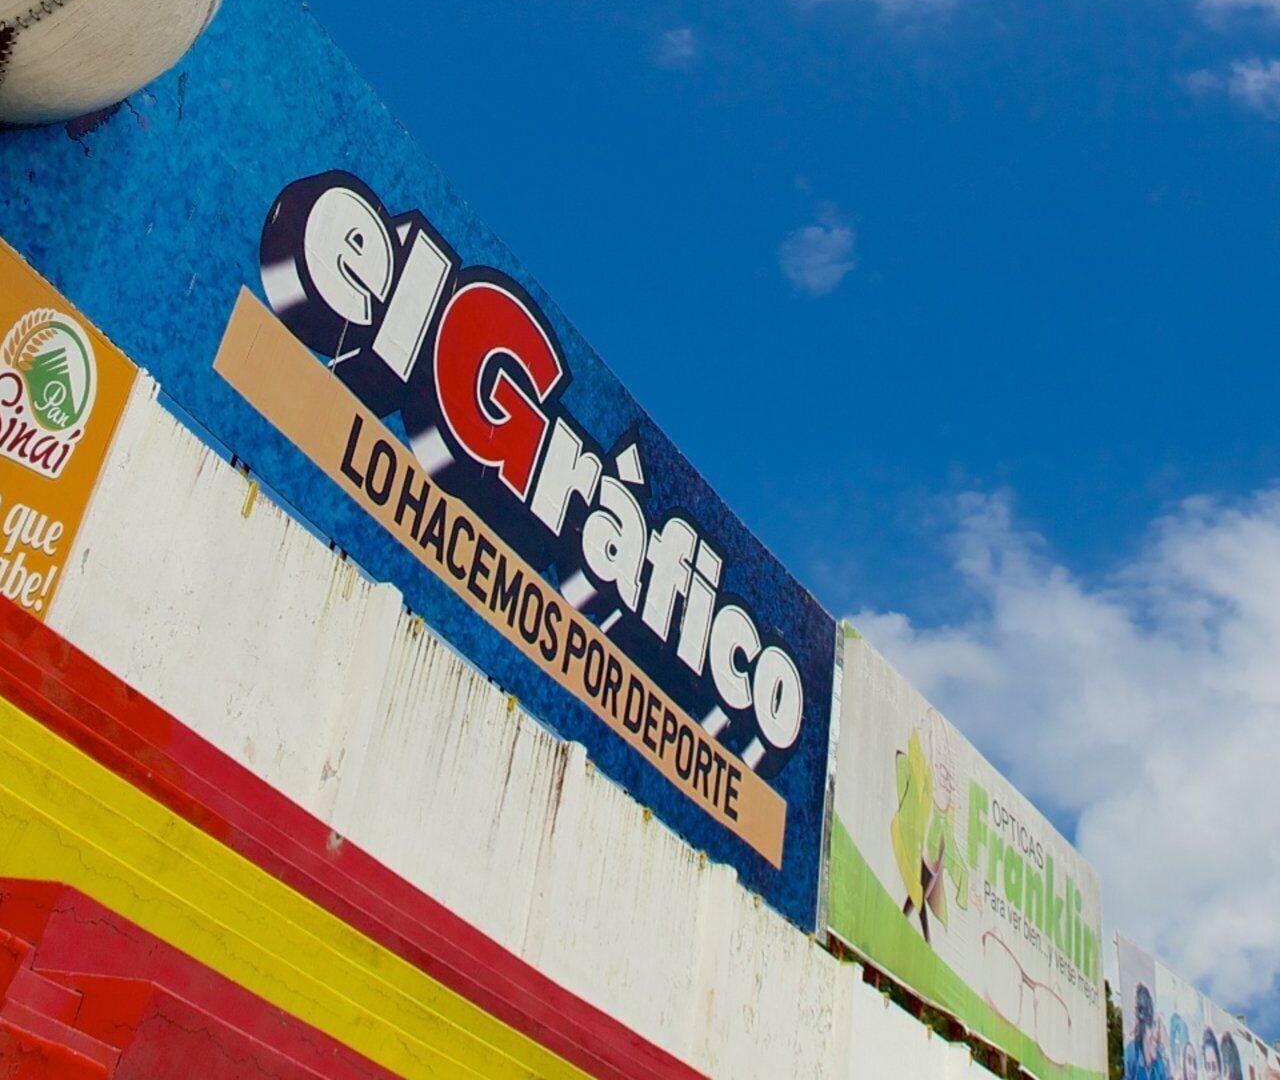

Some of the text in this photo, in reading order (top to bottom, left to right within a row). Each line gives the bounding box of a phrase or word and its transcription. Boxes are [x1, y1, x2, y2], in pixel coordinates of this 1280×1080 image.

[34, 380, 70, 428] Pan
[2, 503, 64, 556] que
[340, 413, 742, 823] LO HACEMOS POR DEPORTE
[991, 799, 1044, 870] OPTICAS
[966, 781, 1100, 987] Franklin
[983, 880, 1006, 920] Para
[1007, 905, 1022, 933] ver
